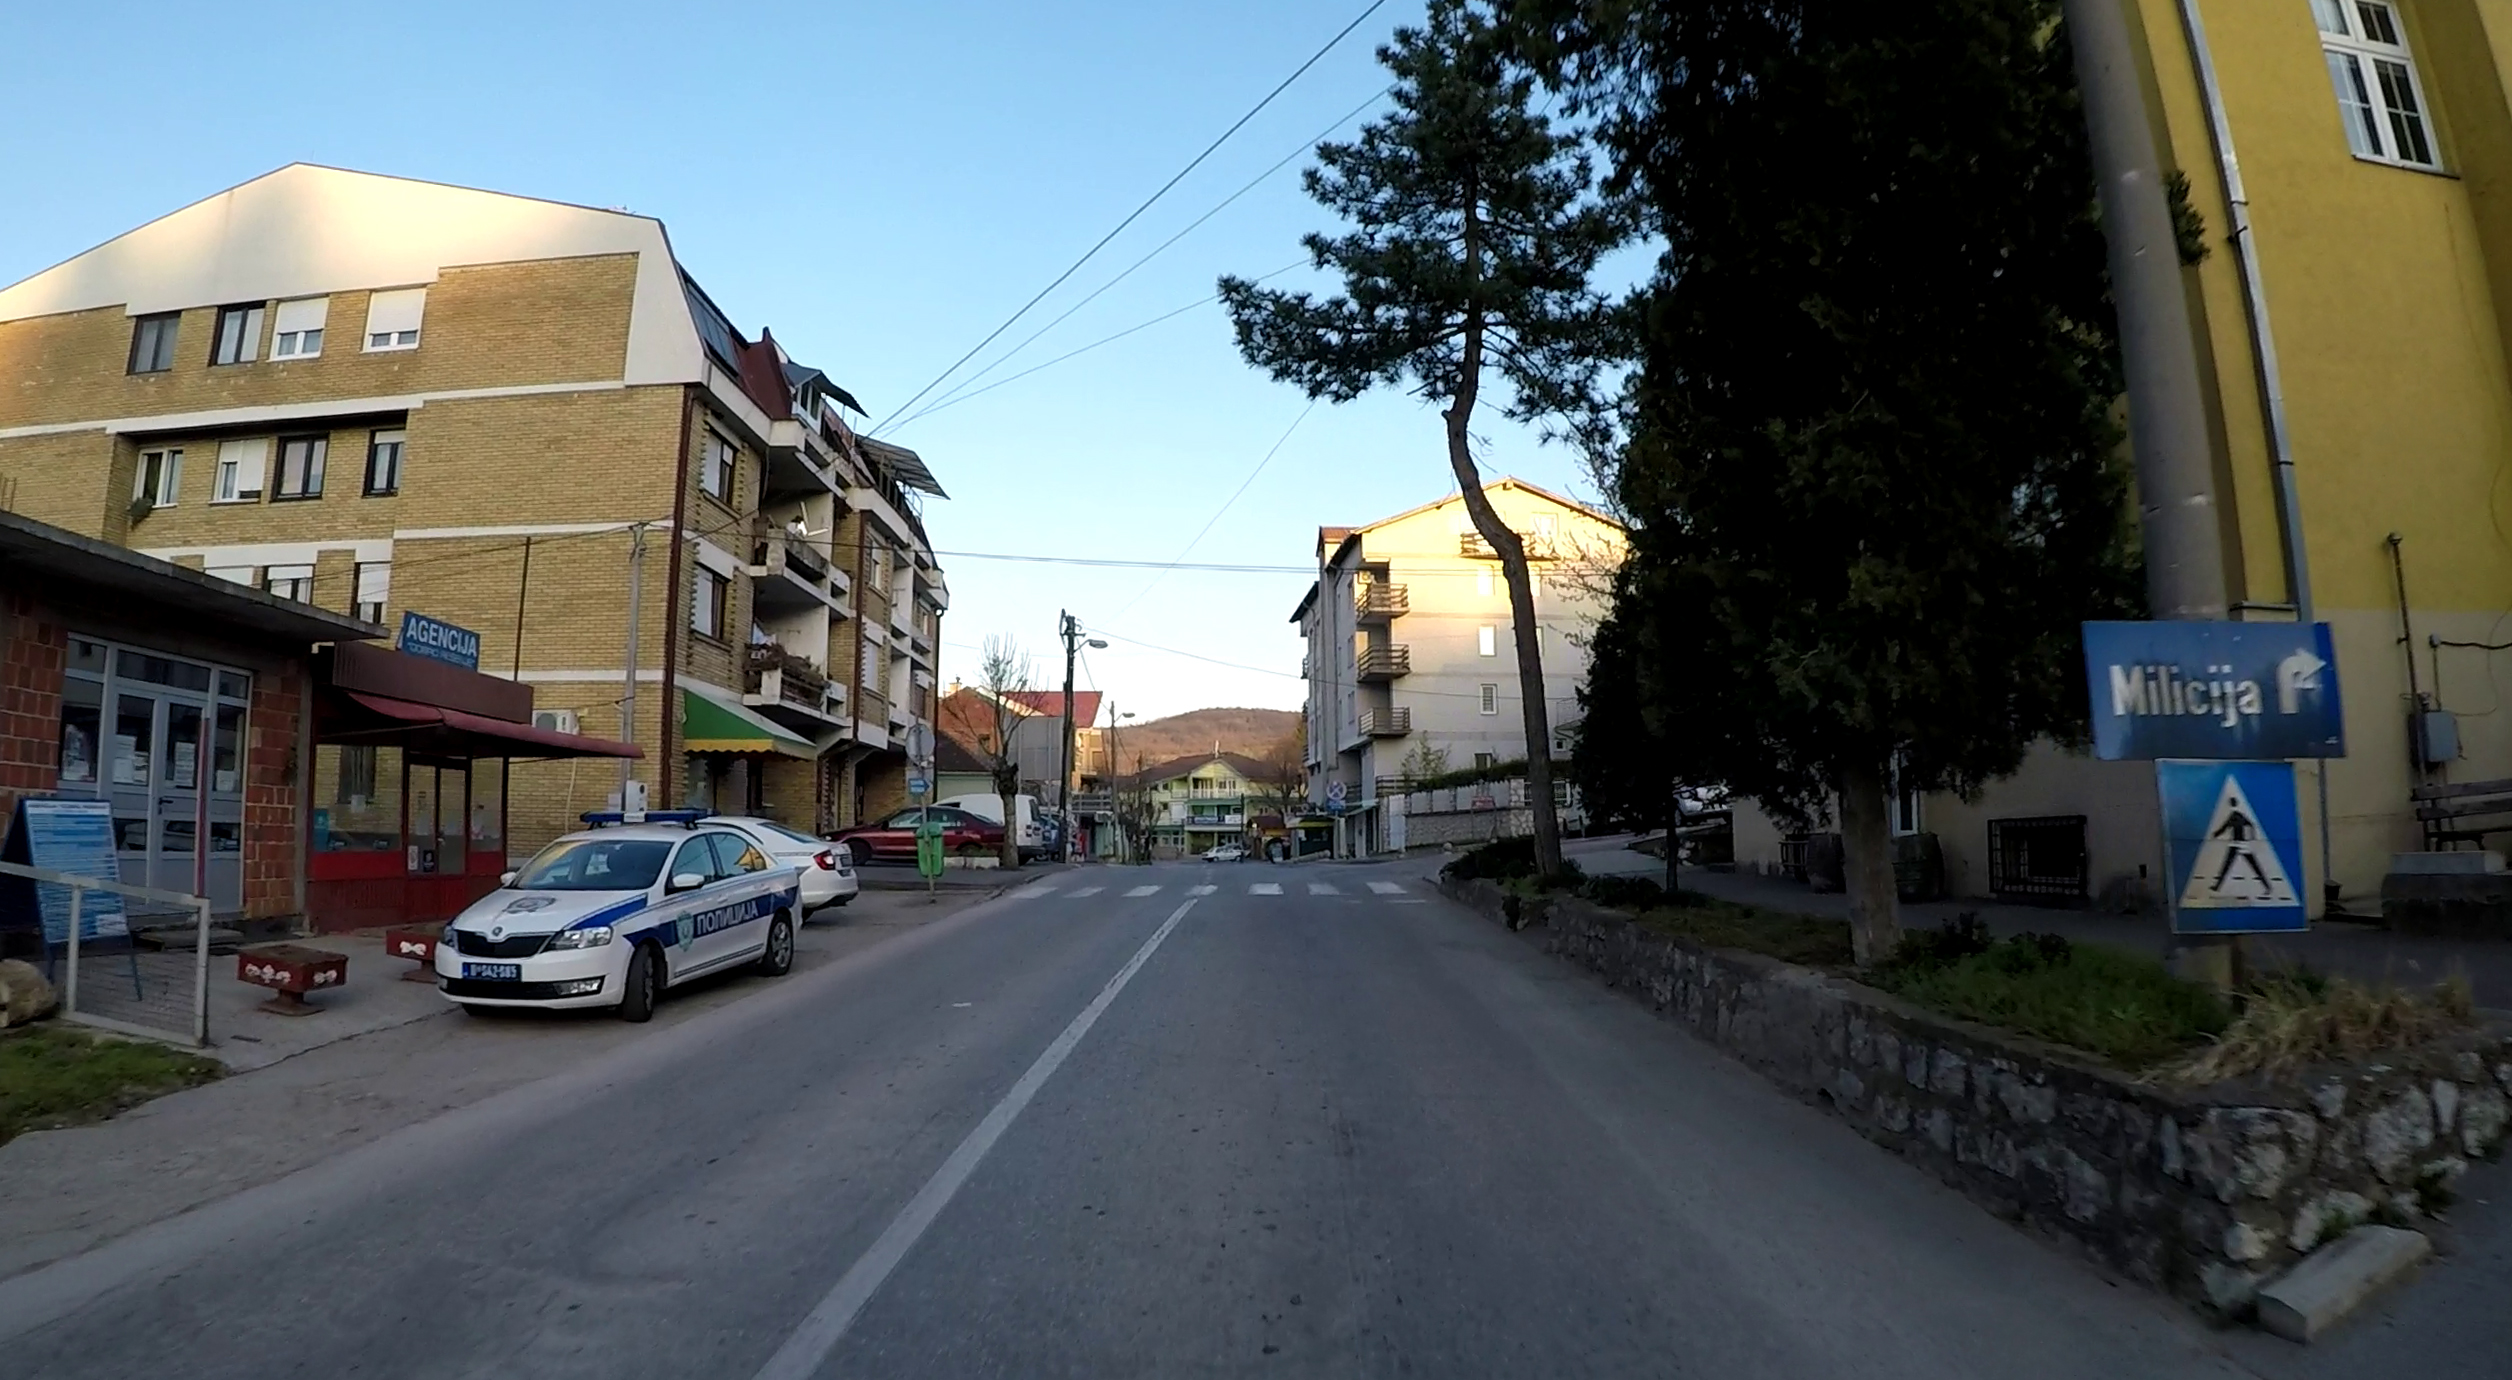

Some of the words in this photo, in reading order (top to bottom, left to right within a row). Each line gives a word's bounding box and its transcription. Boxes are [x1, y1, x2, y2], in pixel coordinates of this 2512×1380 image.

[406, 617, 477, 657] AGENCIJA
[2109, 664, 2263, 728] Milicija
[697, 900, 759, 935] ПОЛИЦИЈА
